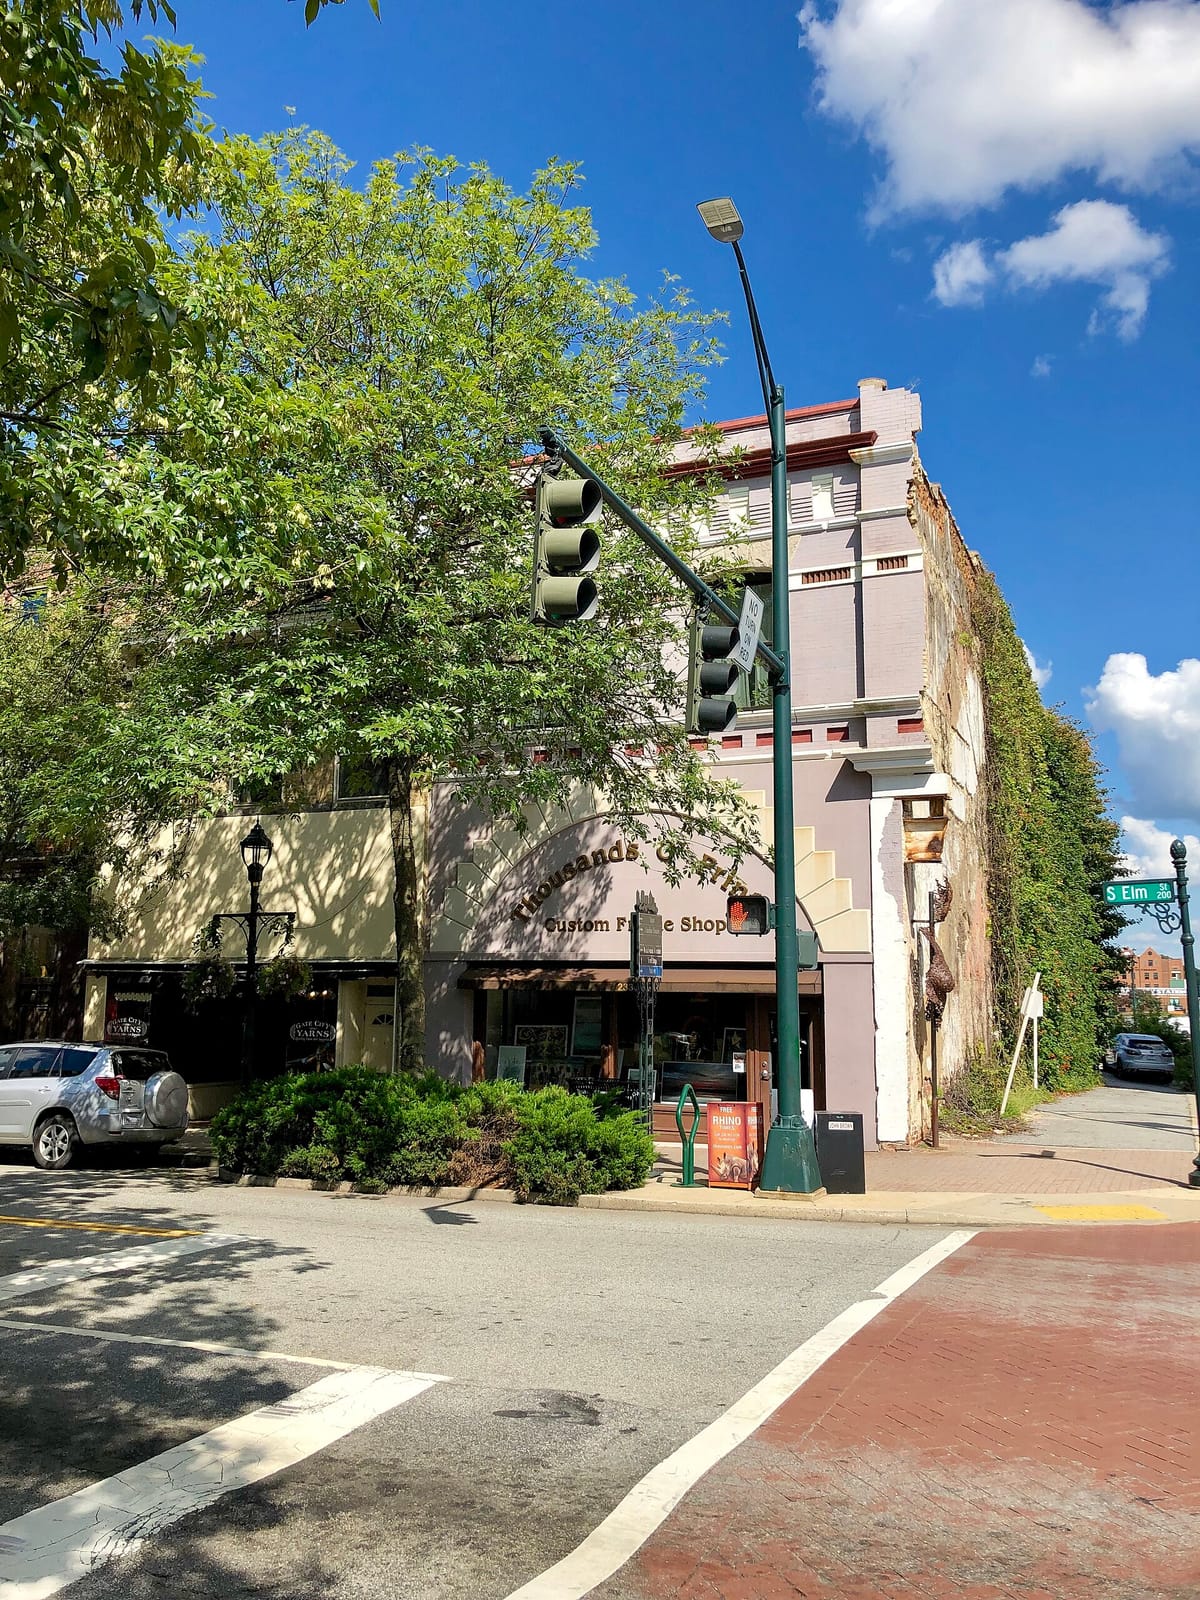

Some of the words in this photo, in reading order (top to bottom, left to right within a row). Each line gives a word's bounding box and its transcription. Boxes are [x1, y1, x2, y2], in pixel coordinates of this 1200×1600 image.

[748, 599, 759, 617] NO
[745, 615, 756, 635] TURN
[744, 633, 752, 647] ON
[740, 646, 750, 662] RED
[510, 839, 640, 921] Thousands
[1106, 886, 1116, 900] S
[1121, 885, 1148, 900] Elm
[1159, 882, 1168, 891] St
[1156, 890, 1172, 899] 200
[544, 917, 610, 933] Custom
[616, 916, 674, 933] Fre
[128, 1016, 142, 1026] CITY
[295, 1020, 313, 1029] GATE
[314, 1020, 331, 1030] CITY
[112, 1025, 142, 1033] YARNS
[297, 1029, 330, 1038] YARNS
[712, 1115, 742, 1126] RHINO
